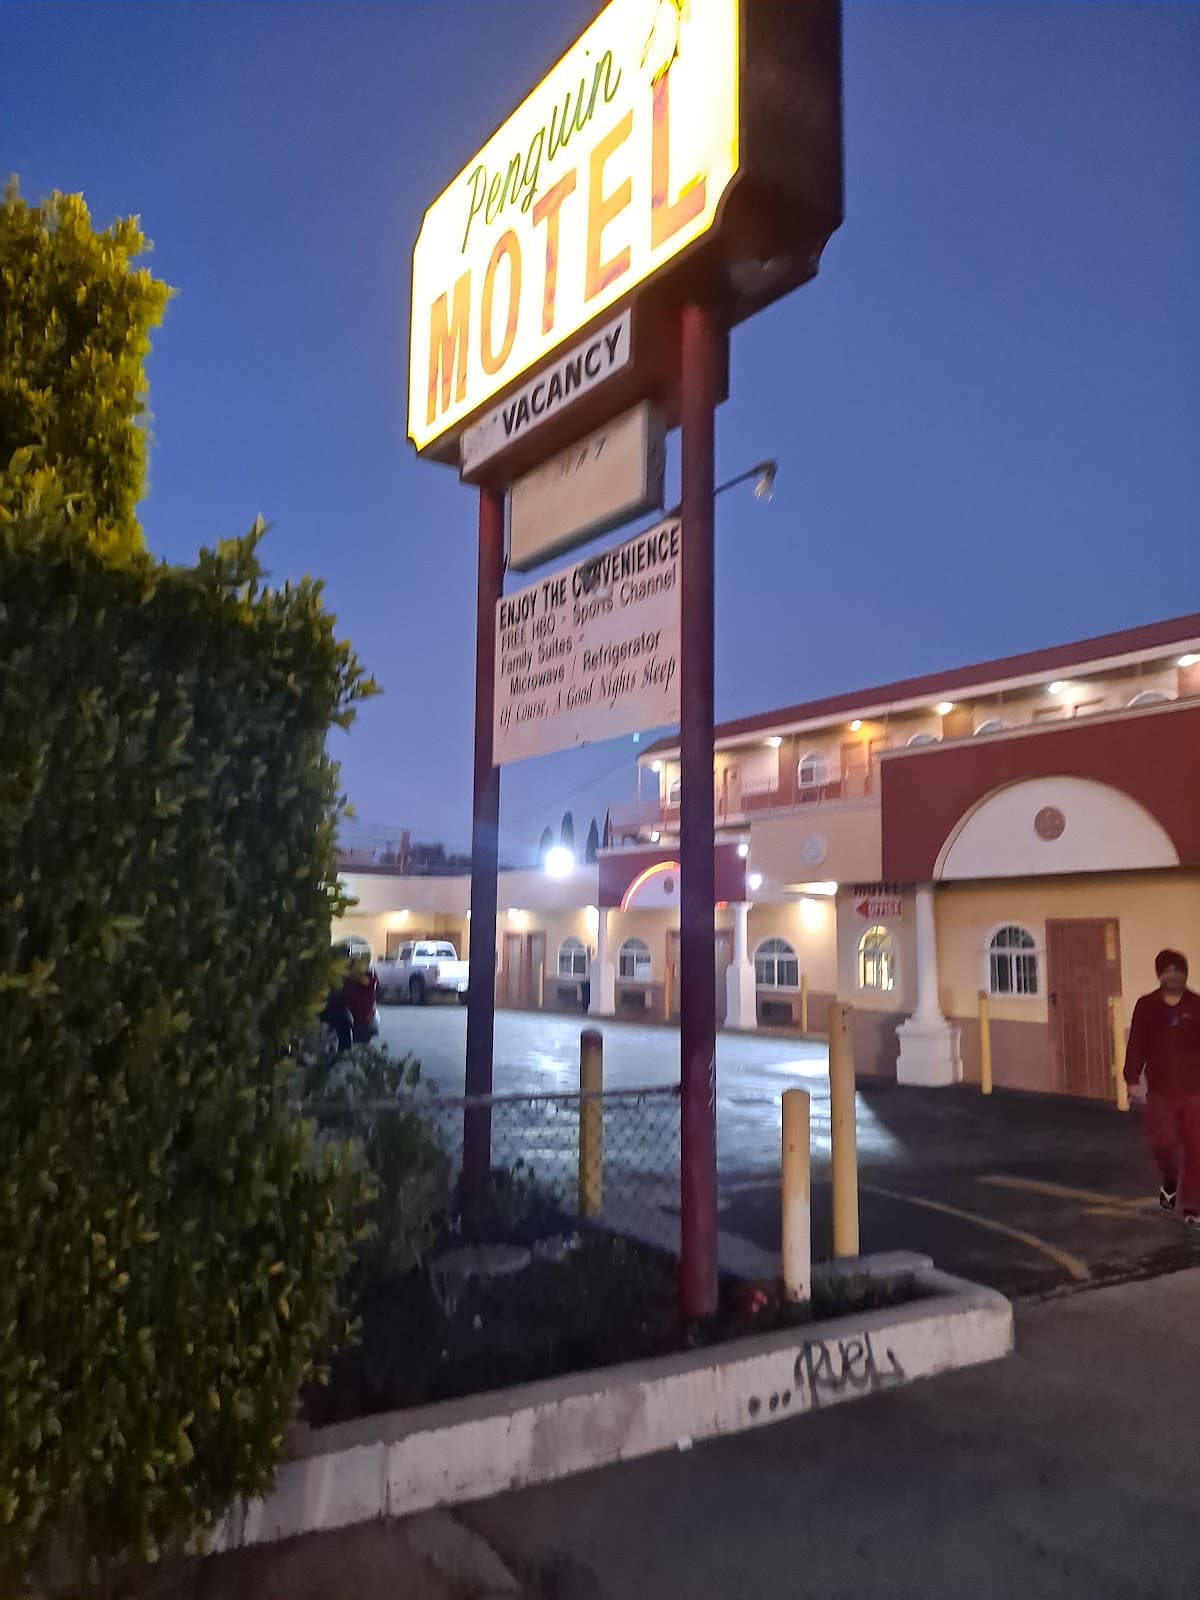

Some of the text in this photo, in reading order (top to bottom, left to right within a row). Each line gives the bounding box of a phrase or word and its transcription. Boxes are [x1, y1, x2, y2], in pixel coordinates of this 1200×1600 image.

[462, 49, 622, 254] Penguin
[426, 72, 706, 427] MOTEL
[502, 325, 622, 437] VACANCY
[500, 589, 537, 630] ENJOY
[543, 576, 567, 611] THE
[501, 627, 527, 652] FREE
[532, 614, 556, 640] HBO
[620, 563, 676, 608] Channel
[501, 635, 573, 680] Family Suites
[510, 664, 565, 697] Microwave
[583, 629, 662, 673] Refrigerator
[567, 678, 594, 711] Good
[599, 667, 637, 710] Nights
[641, 654, 677, 696] Sleep
